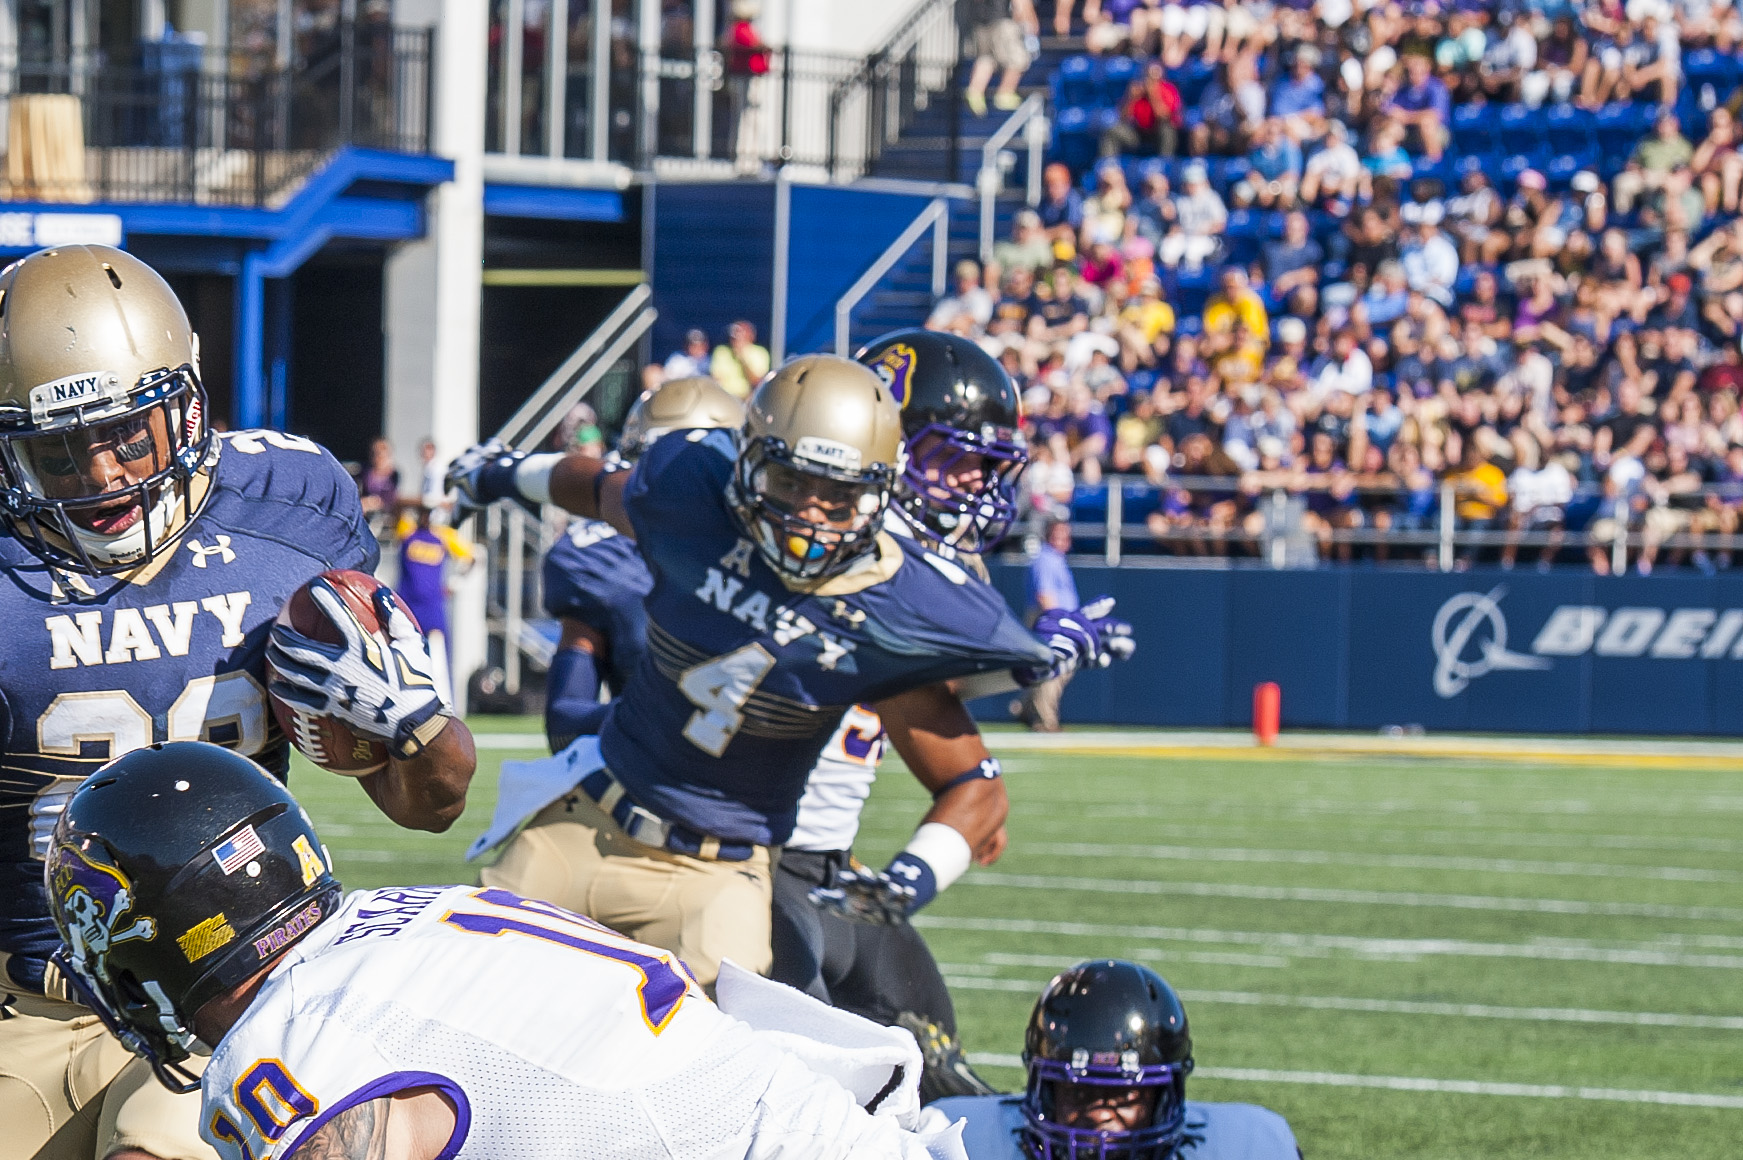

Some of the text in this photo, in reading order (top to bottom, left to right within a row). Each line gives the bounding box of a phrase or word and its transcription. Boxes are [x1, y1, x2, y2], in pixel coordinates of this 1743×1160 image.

[53, 376, 97, 400] NAVY
[44, 590, 252, 670] NAVY
[695, 567, 858, 672] NAVY
[1532, 604, 1743, 661] BOEI
[678, 642, 777, 758] 4
[253, 901, 323, 960] PIRATES
